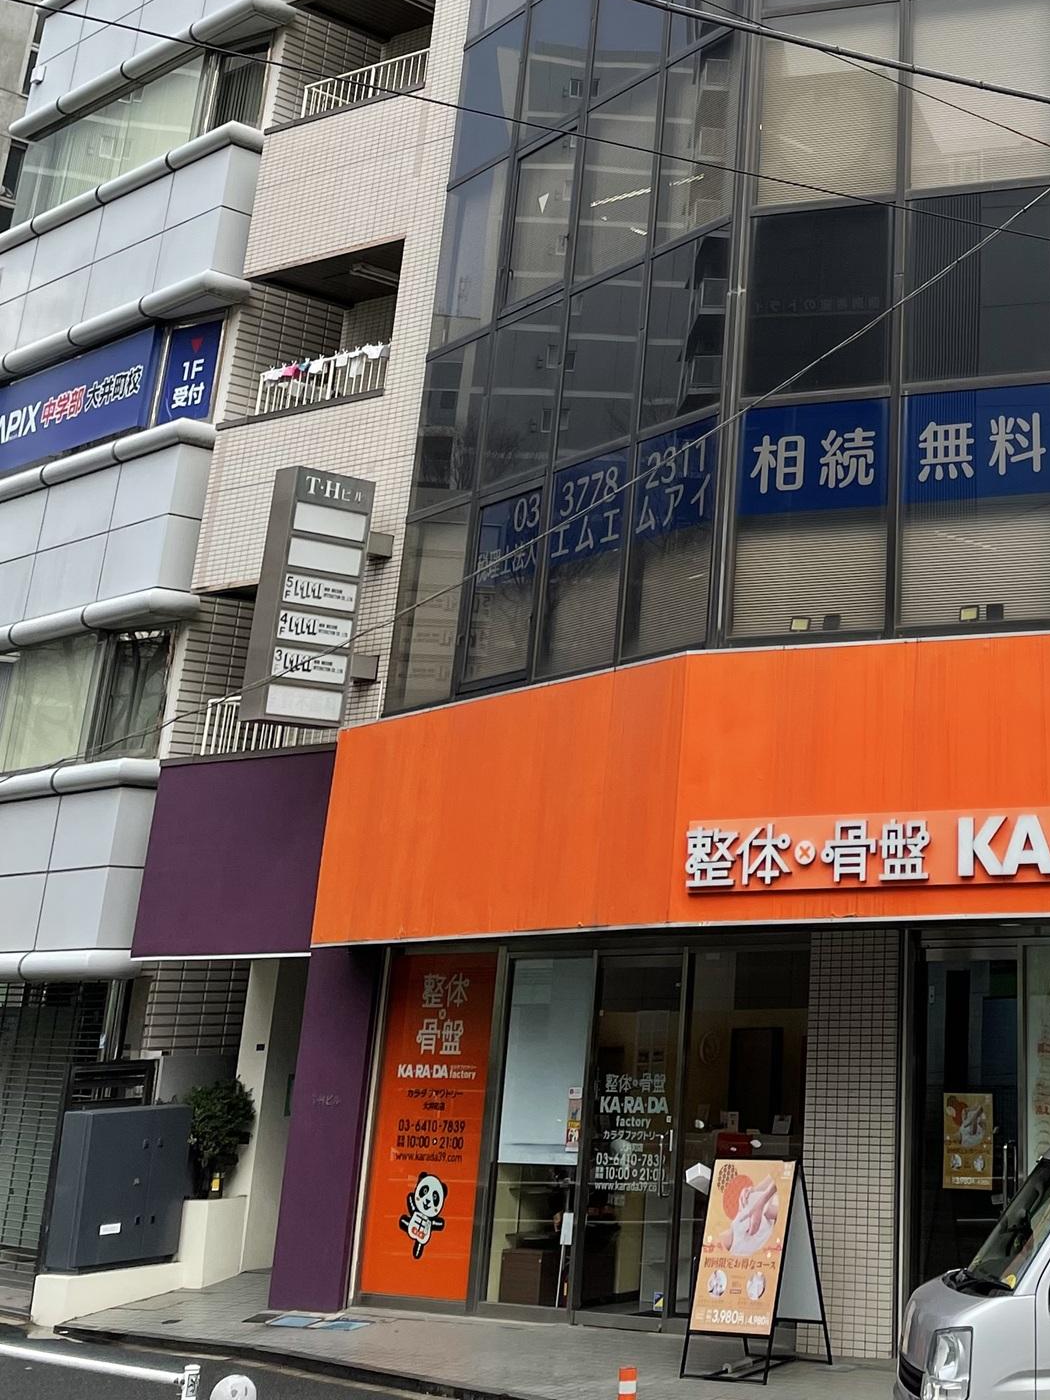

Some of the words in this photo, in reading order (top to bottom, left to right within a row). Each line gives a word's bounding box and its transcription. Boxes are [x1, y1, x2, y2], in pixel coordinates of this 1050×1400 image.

[182, 359, 204, 381] 1F
[40, 385, 86, 428] 中学部
[84, 365, 144, 413] 大井町校
[171, 382, 204, 409] 受付
[750, 427, 876, 494] 相続
[918, 412, 1047, 482] 無料
[422, 972, 470, 1008] 整体
[416, 1019, 464, 1055] 骨盤
[398, 1118, 466, 1133] 03-6410-7839
[615, 1115, 652, 1129] factory
